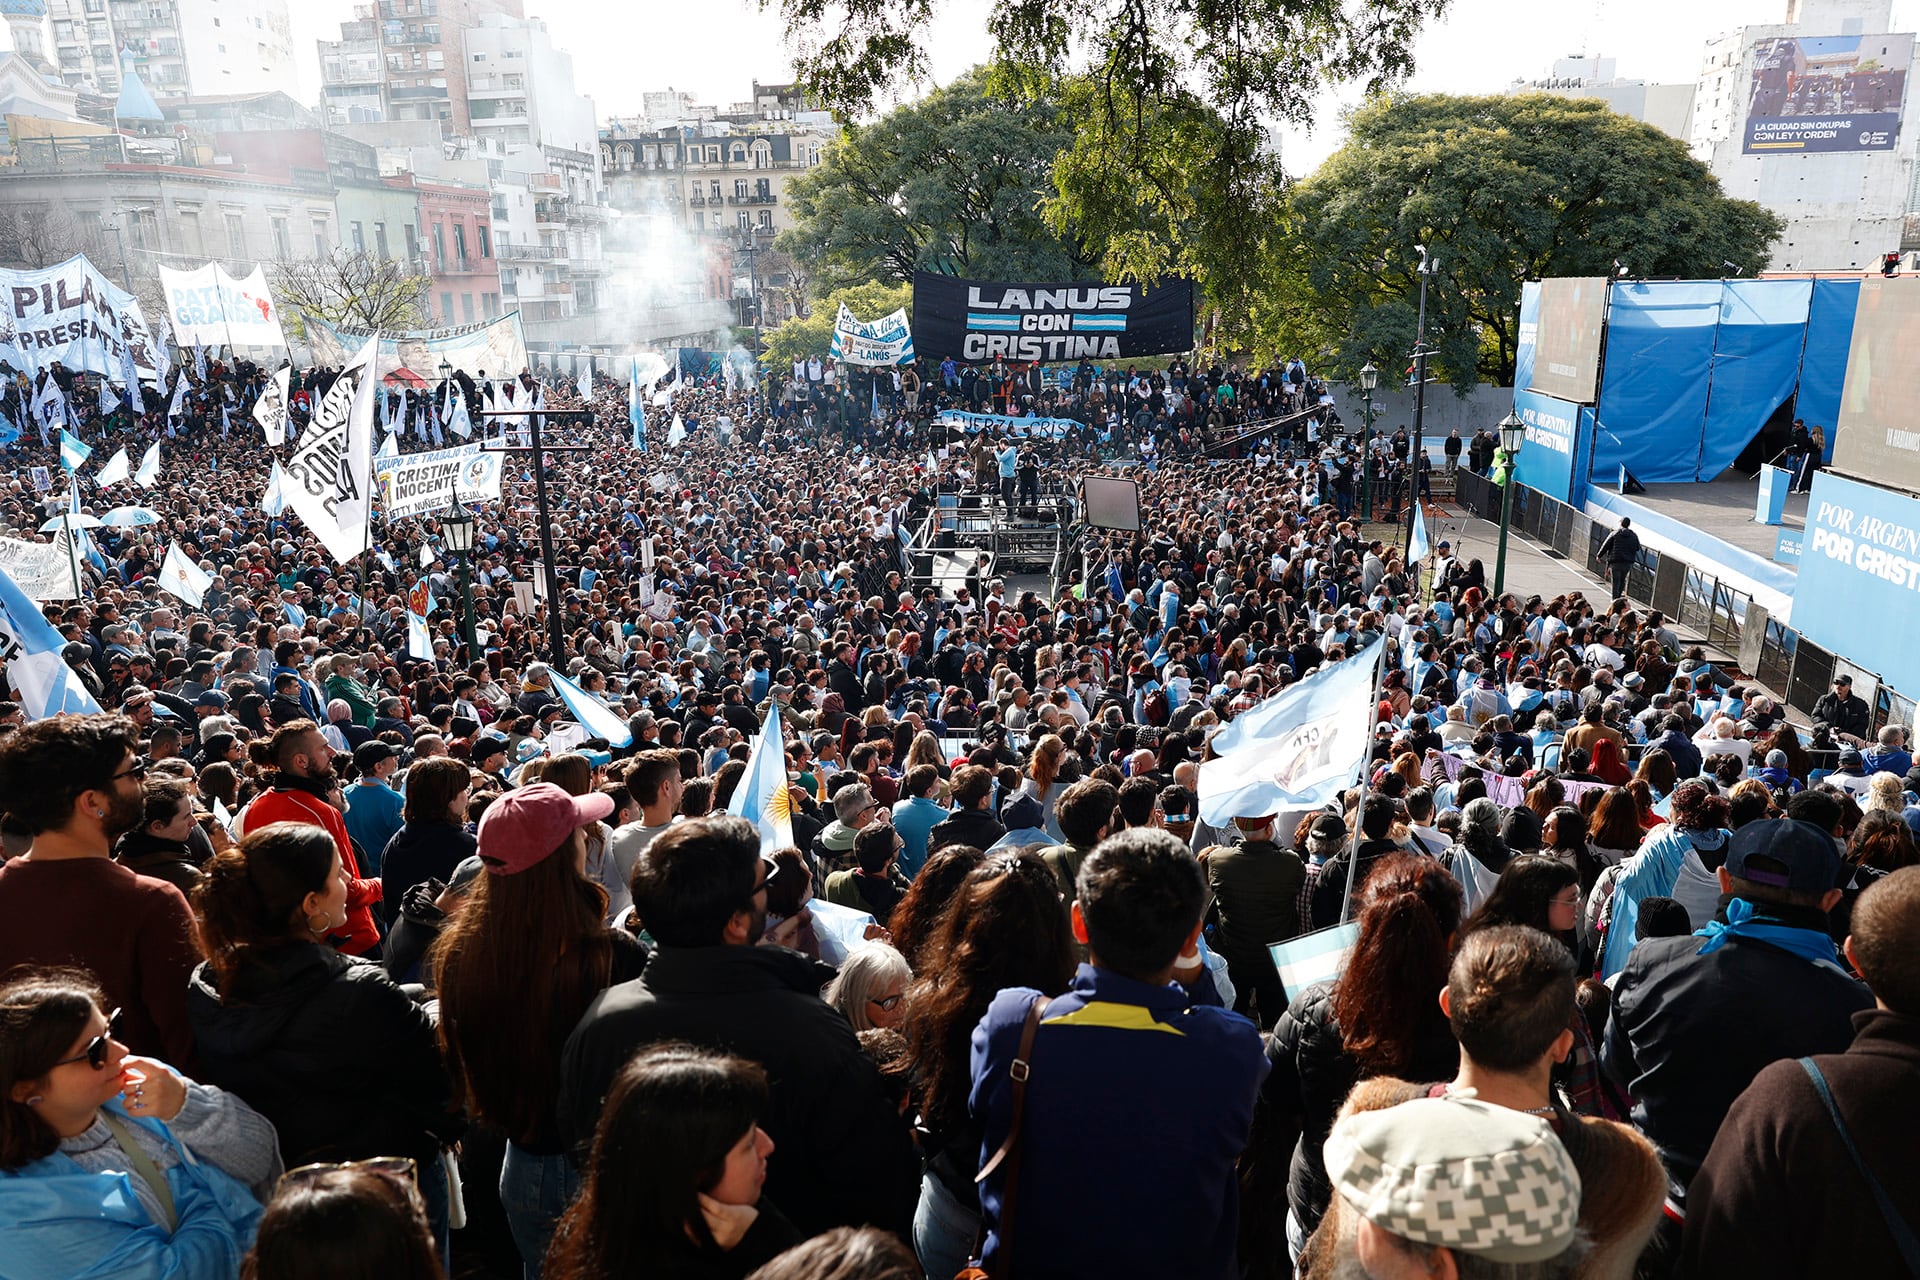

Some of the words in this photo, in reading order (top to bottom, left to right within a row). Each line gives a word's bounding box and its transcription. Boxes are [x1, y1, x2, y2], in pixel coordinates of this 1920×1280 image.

[1754, 132, 1774, 140] CON
[1776, 131, 1794, 140] LEY
[1795, 131, 1802, 139] Y
[1804, 130, 1837, 139] ORDEN
[1767, 122, 1799, 131] CIUDAD
[1800, 122, 1816, 130] SIN
[1816, 120, 1851, 129] OKUPAS
[171, 284, 248, 307] PATRIA
[967, 285, 1132, 311] LANUS
[175, 303, 268, 326] GRANDE
[1022, 314, 1070, 332] CON
[18, 319, 126, 360] PRESENTE
[963, 332, 1121, 361] CRISTINA
[952, 412, 1015, 432] FUERZA
[1522, 408, 1536, 426] POR
[1537, 412, 1572, 436] ARGENTINA
[1524, 424, 1535, 443] OR
[1535, 428, 1569, 455] CRISTINA
[376, 456, 404, 472] GRUPO
[406, 456, 418, 465] DE
[421, 450, 460, 464] TRABAJO
[396, 461, 461, 485] CRISTINA
[395, 475, 458, 500] INOCENTE
[444, 490, 484, 507] COCEJAL
[1816, 501, 1855, 534] POR
[1853, 514, 1920, 558] ARGEN
[1780, 545, 1793, 554] POR
[1811, 526, 1855, 566] POR
[1855, 543, 1920, 593] CRIST
